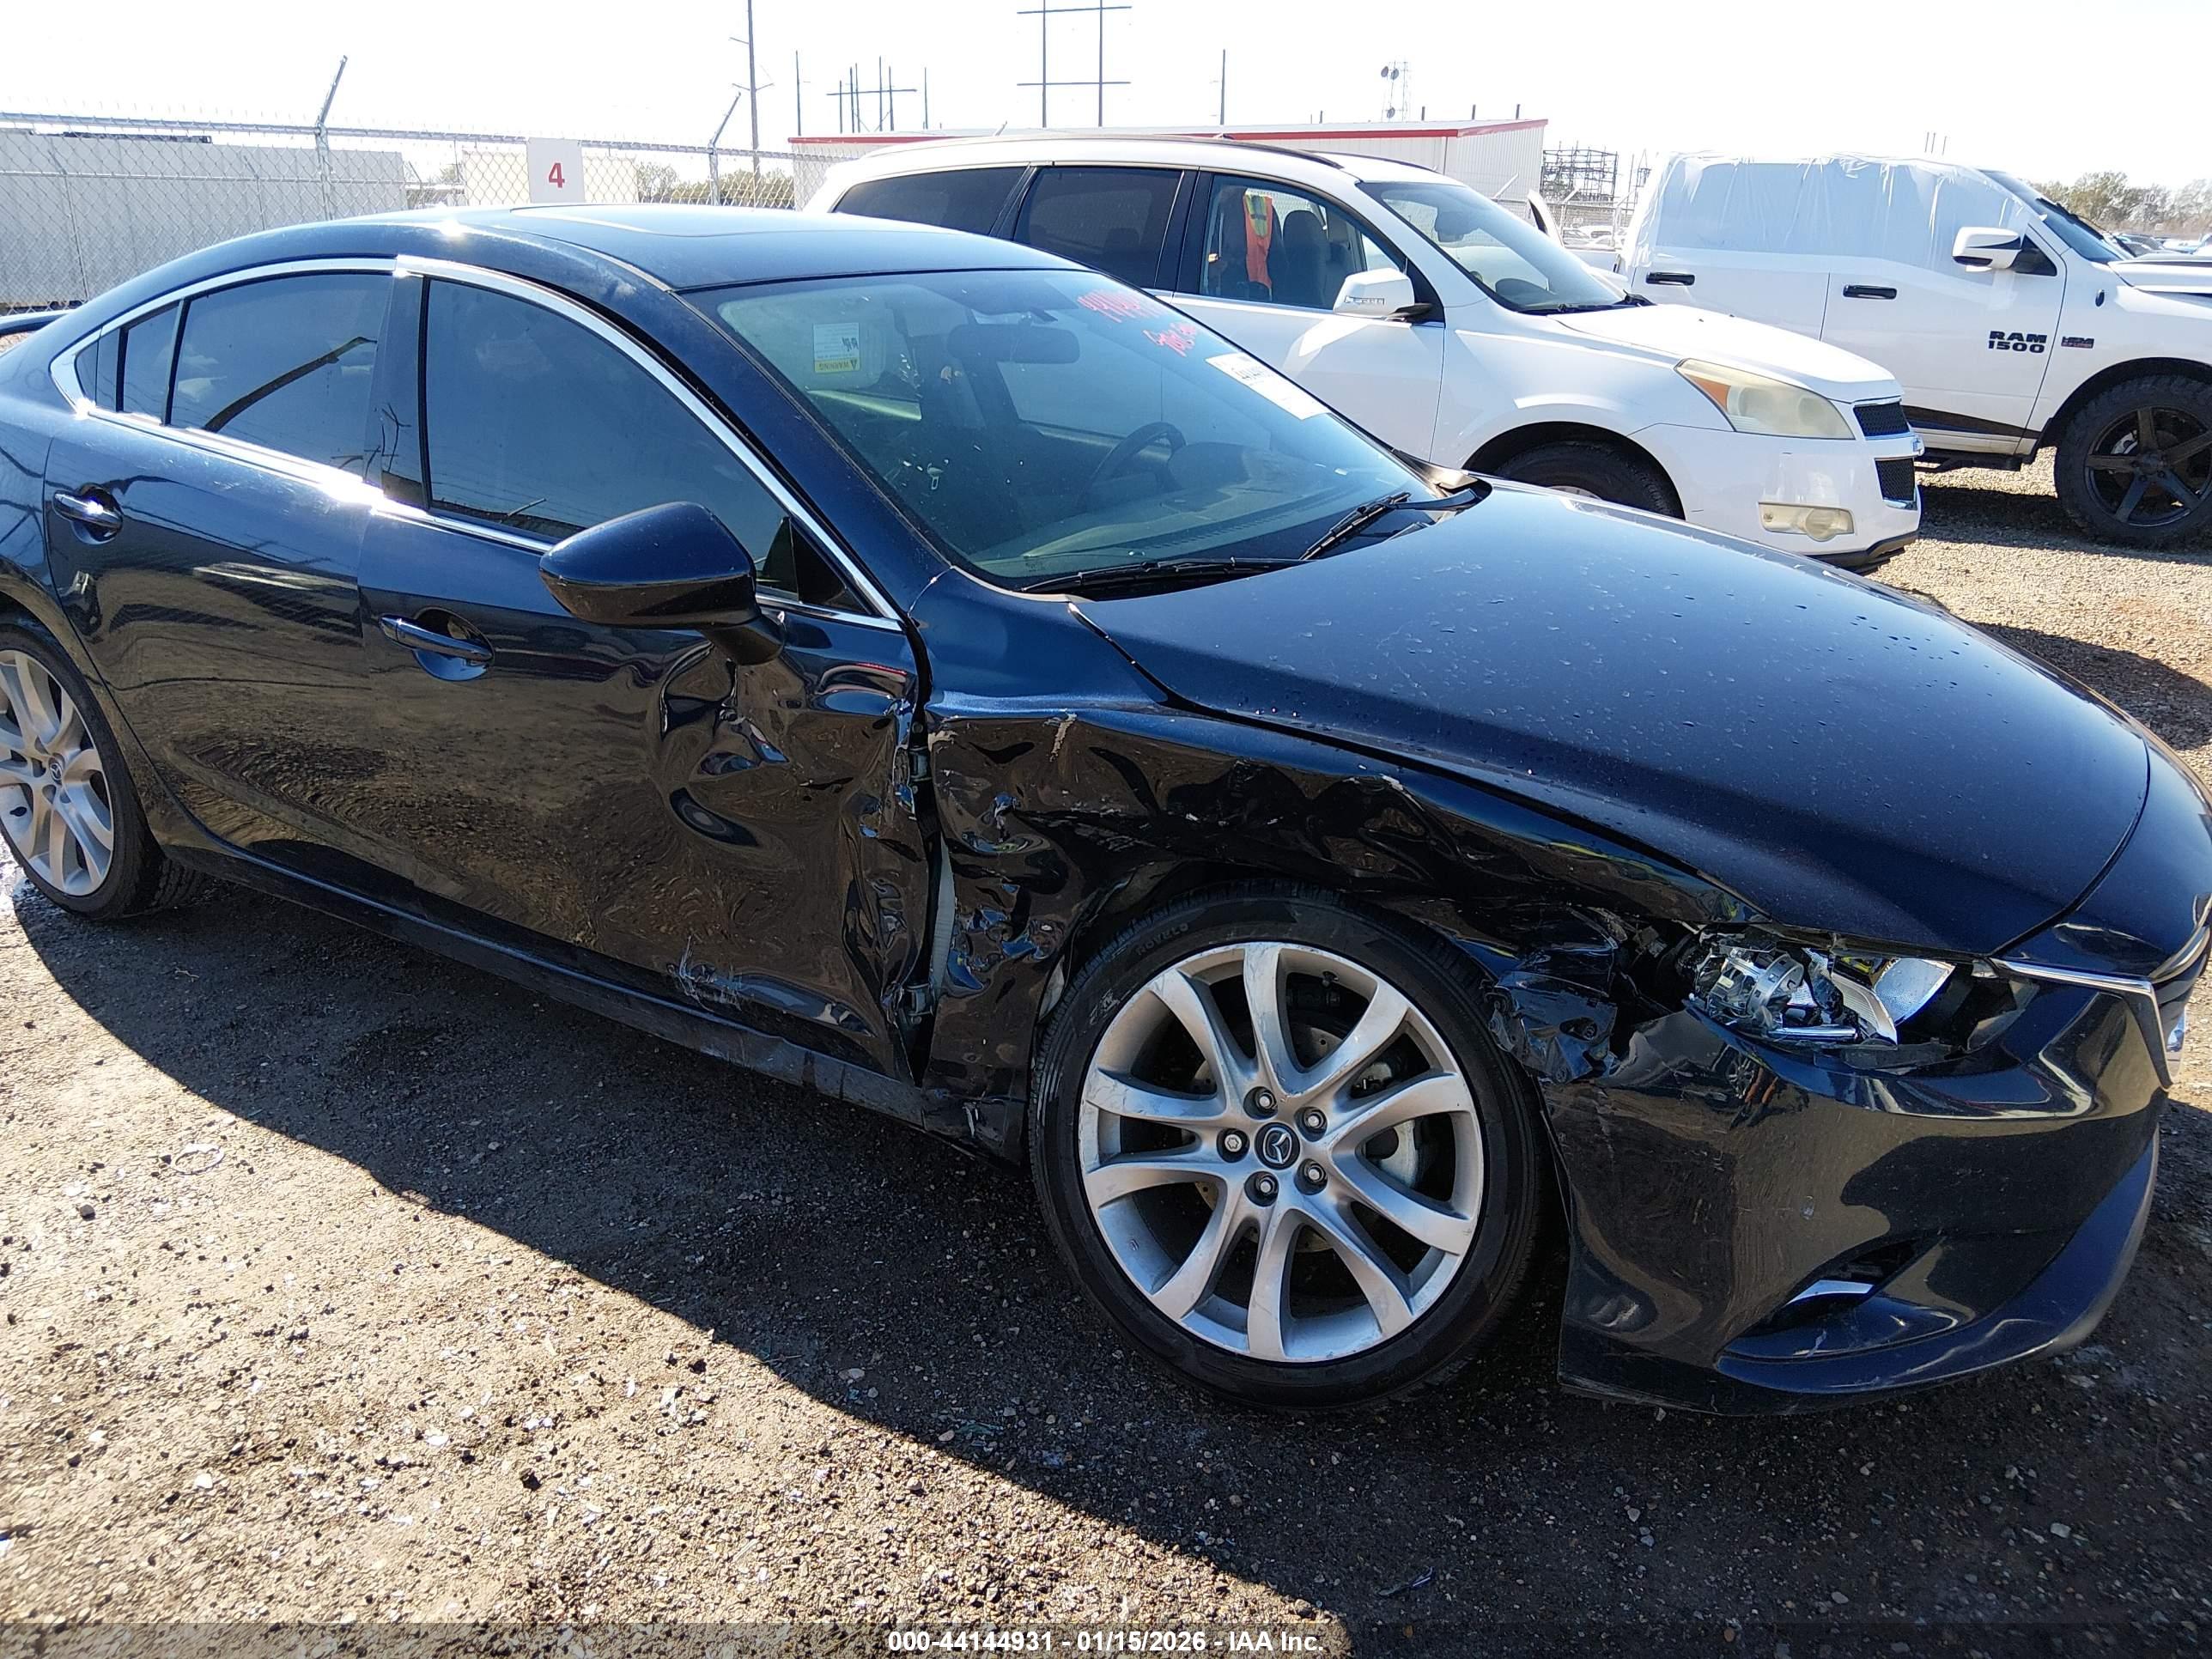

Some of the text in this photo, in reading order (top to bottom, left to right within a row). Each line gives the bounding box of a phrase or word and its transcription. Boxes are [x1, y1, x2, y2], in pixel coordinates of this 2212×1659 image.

[549, 162, 565, 188] 4
[1989, 331, 2047, 343] RAM
[1988, 340, 2045, 353] 1500
